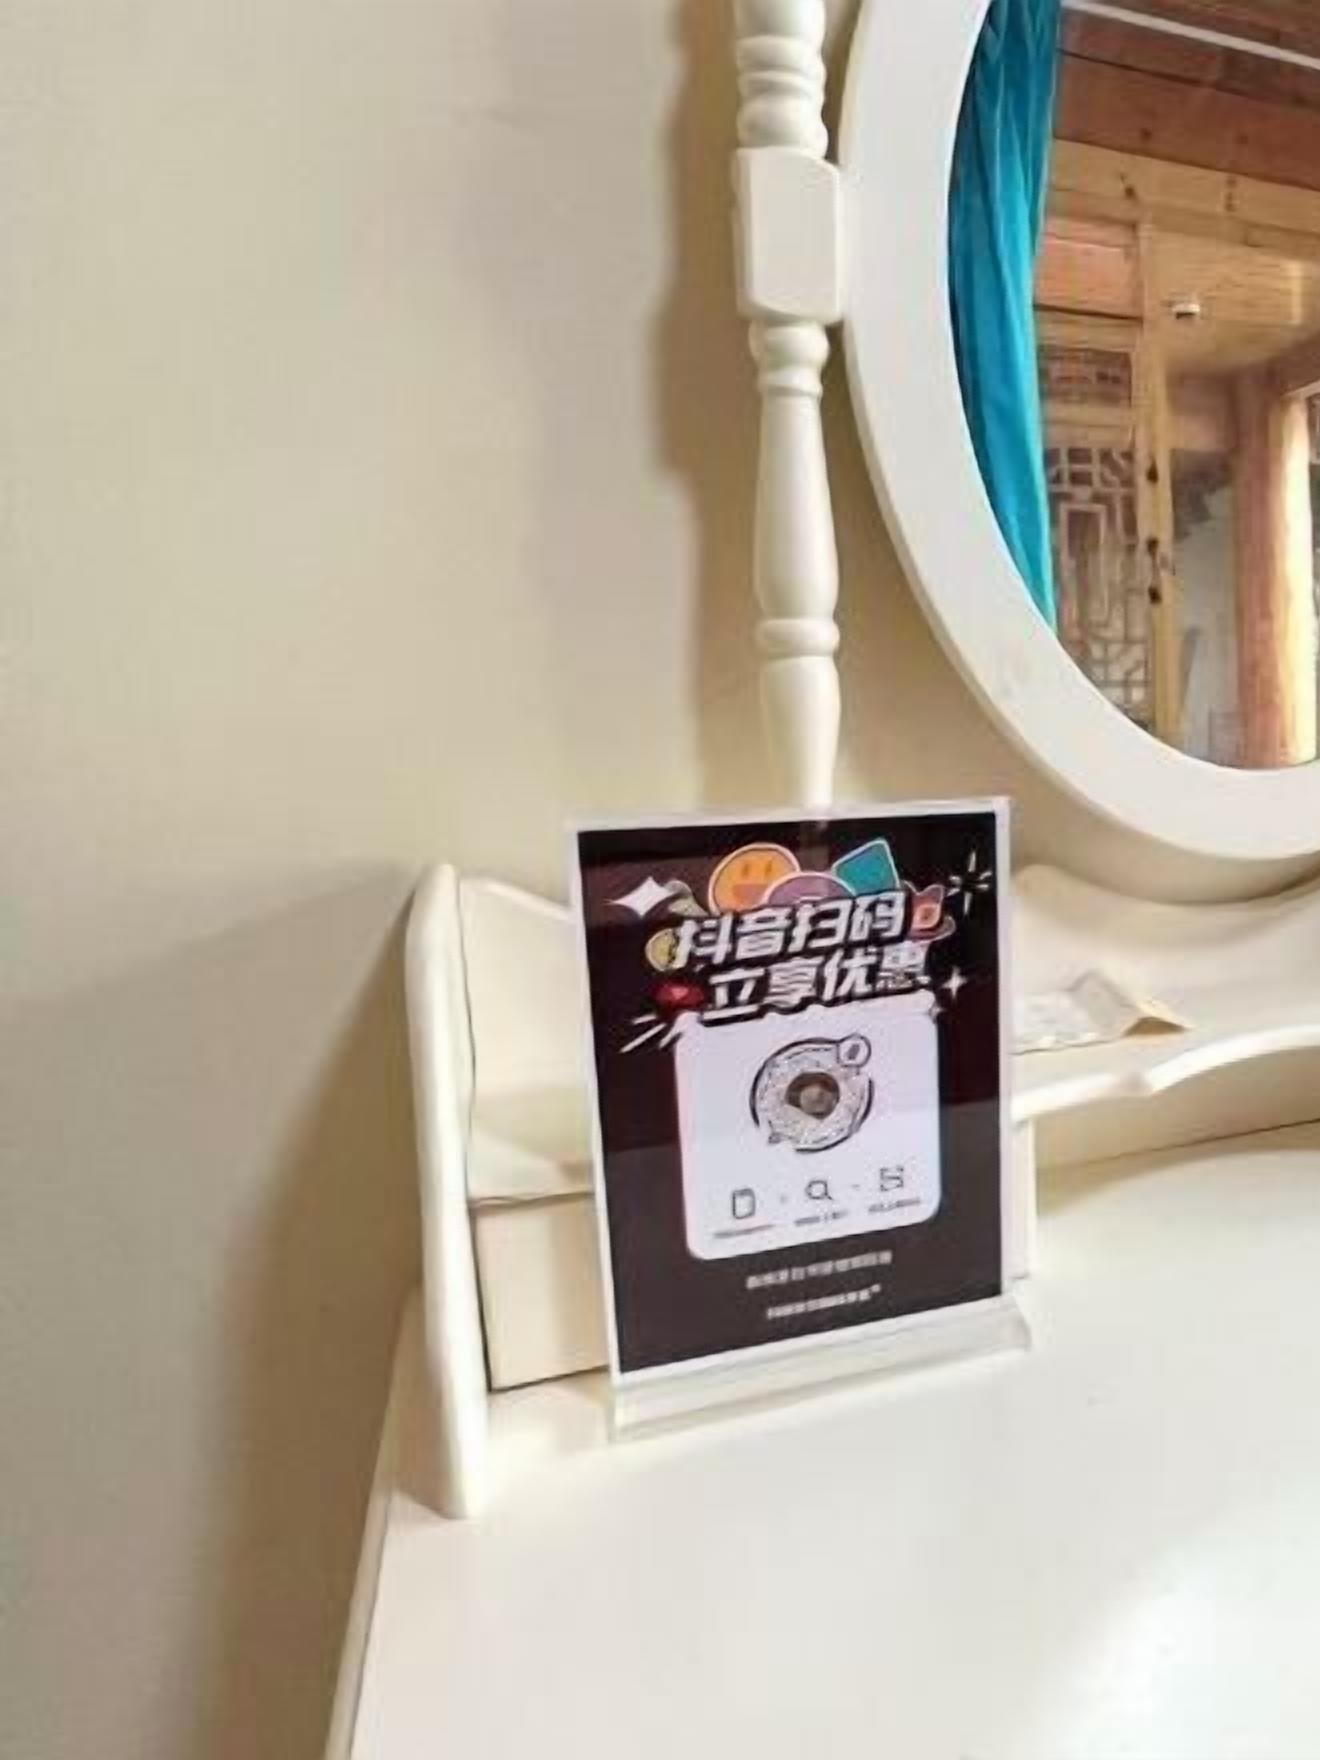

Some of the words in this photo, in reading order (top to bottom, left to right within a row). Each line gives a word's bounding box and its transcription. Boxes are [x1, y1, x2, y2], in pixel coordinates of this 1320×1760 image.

[674, 891, 905, 968] 抖音扫码
[702, 940, 931, 1021] 立享优惠
